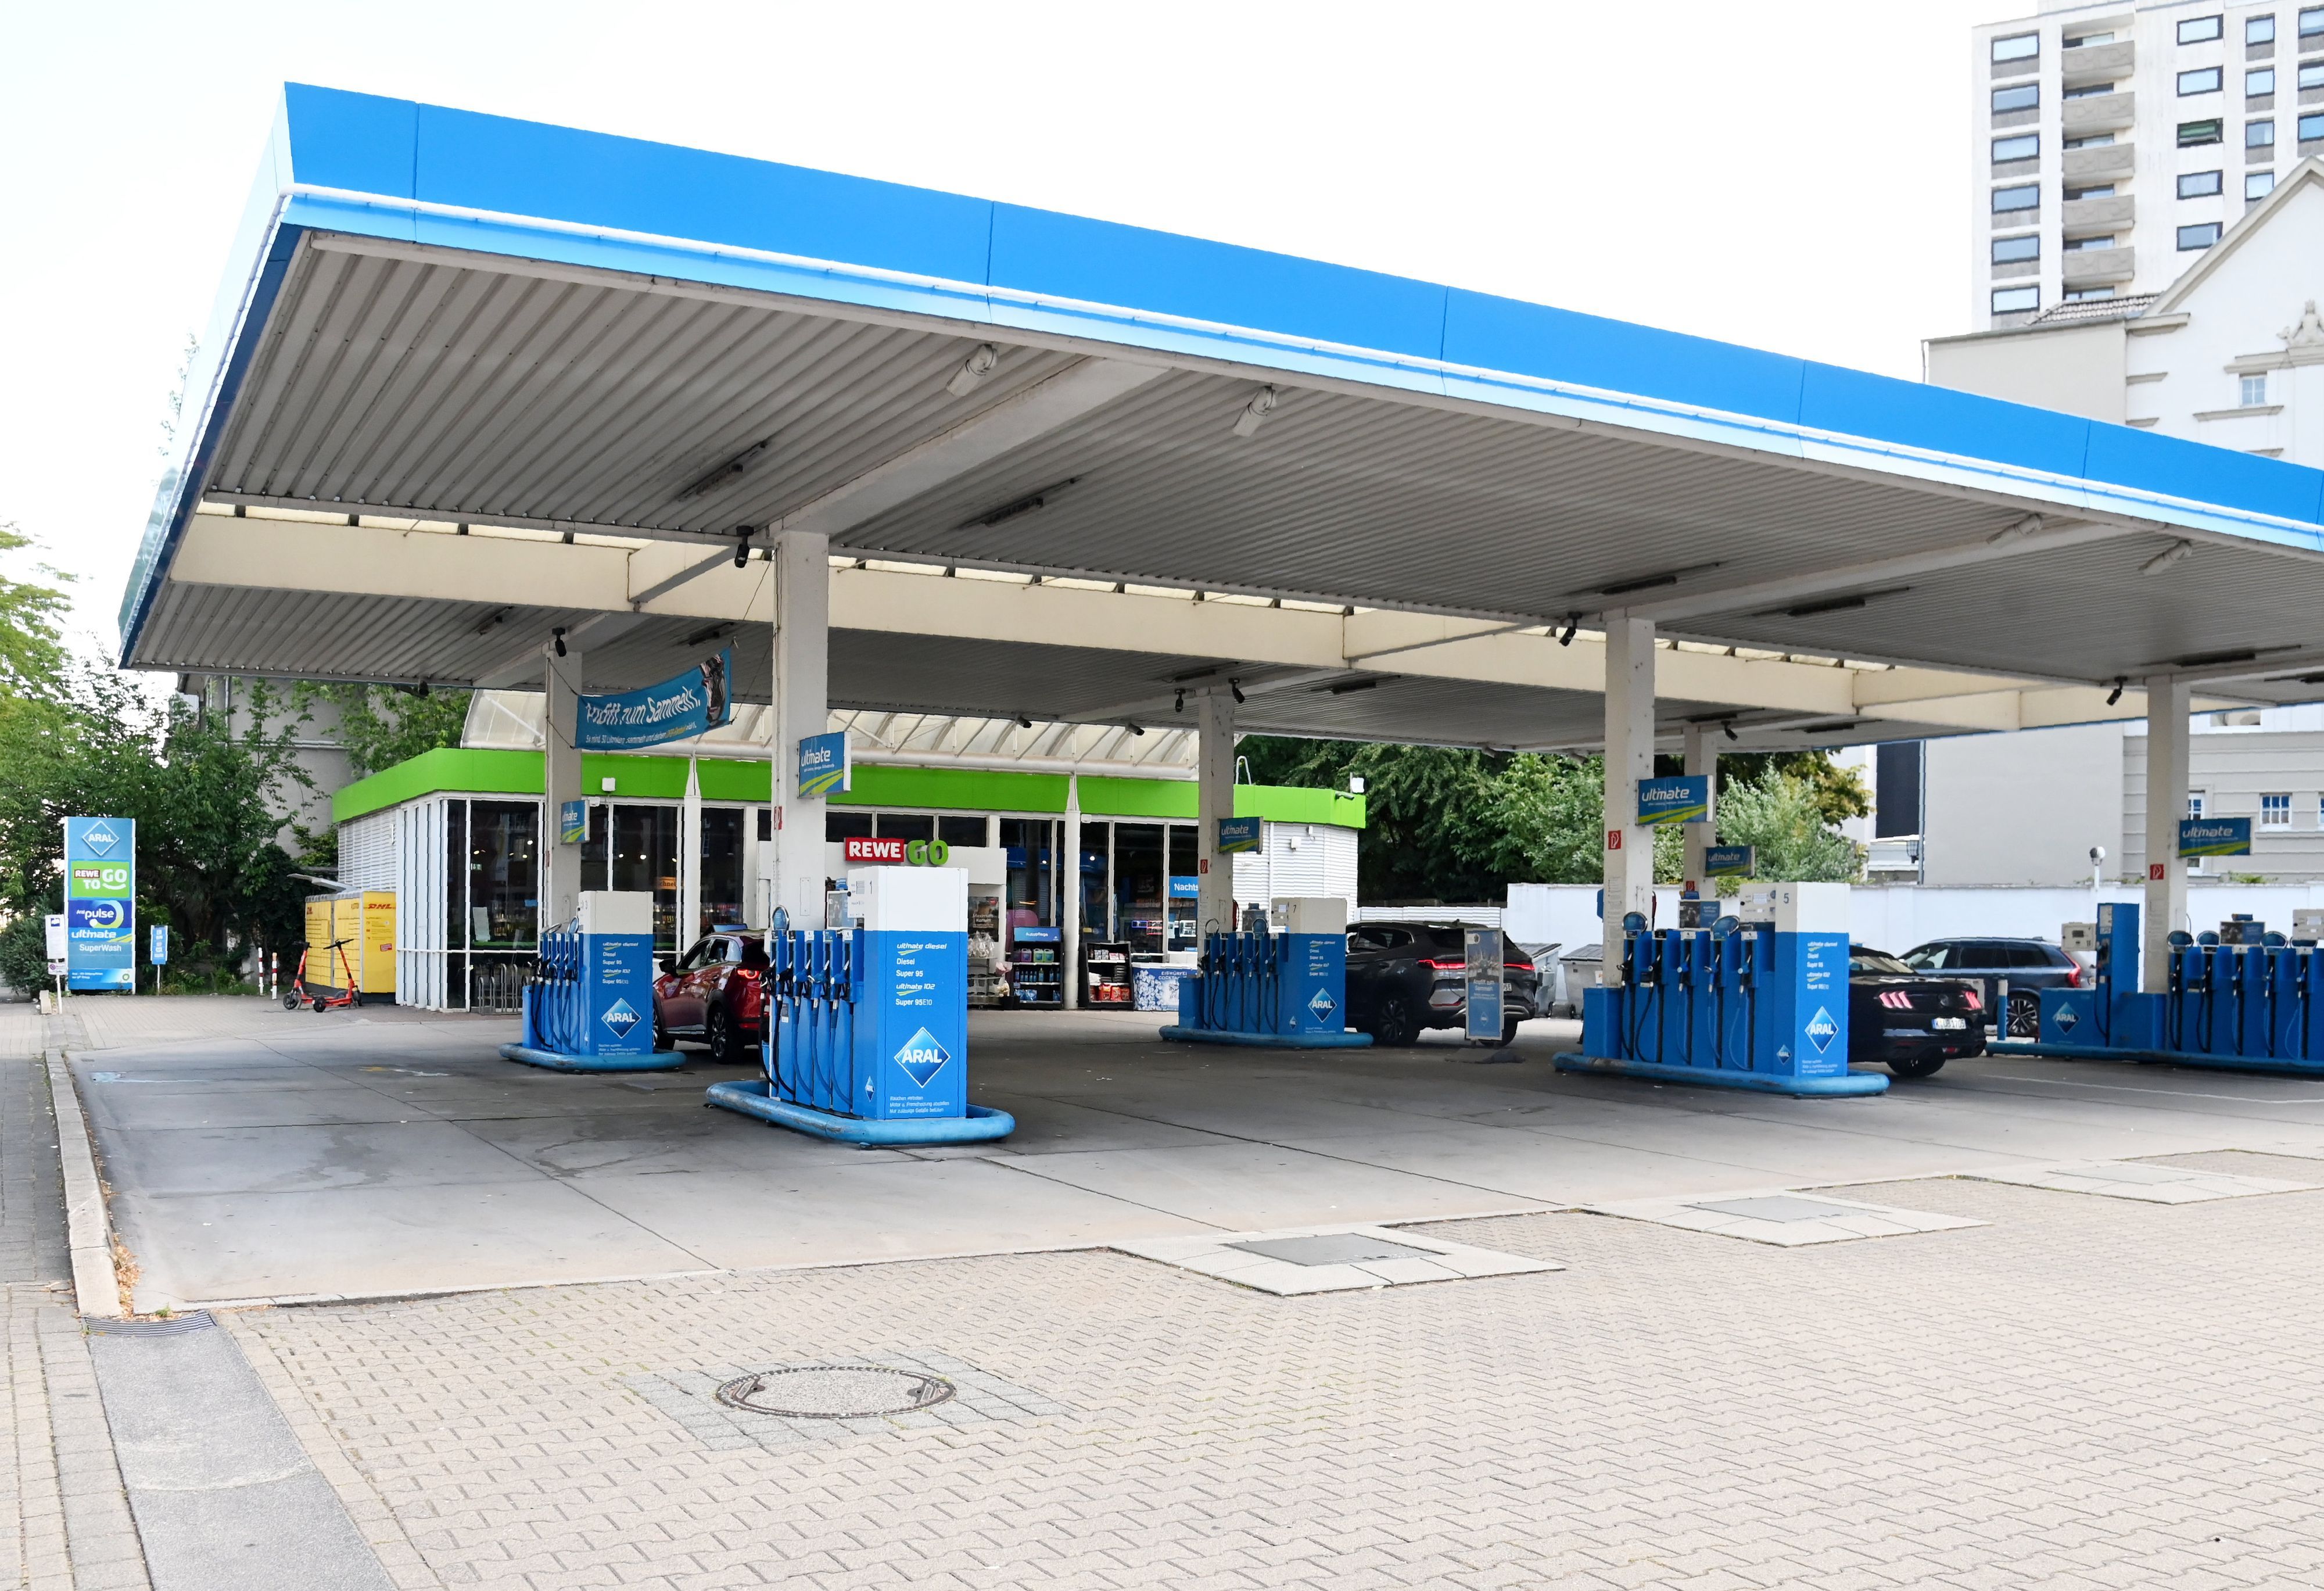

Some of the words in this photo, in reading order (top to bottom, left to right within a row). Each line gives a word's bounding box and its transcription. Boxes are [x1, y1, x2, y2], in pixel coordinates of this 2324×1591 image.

[801, 746, 831, 766] ultimate
[1642, 786, 1690, 801] ultimate
[1221, 825, 1249, 835] ultimate
[2182, 825, 2233, 838] ultimate
[88, 833, 114, 842] ARAL
[849, 841, 901, 858] REWE
[906, 840, 948, 865] GO
[1708, 852, 1740, 862] ultimate
[102, 869, 127, 883] GO
[83, 879, 101, 889] TO
[1783, 893, 1789, 904] 5
[85, 908, 114, 920] pulse
[1293, 905, 1297, 913] 7
[71, 929, 116, 938] ultimate
[80, 944, 122, 952] SuperWash
[896, 970, 914, 978] Super
[1312, 1001, 1333, 1009] ARAL
[607, 1013, 636, 1022] ARAL
[2056, 1013, 2076, 1022] ARAL
[1810, 1023, 1834, 1034] ARAL
[901, 1049, 942, 1063] ARAL
